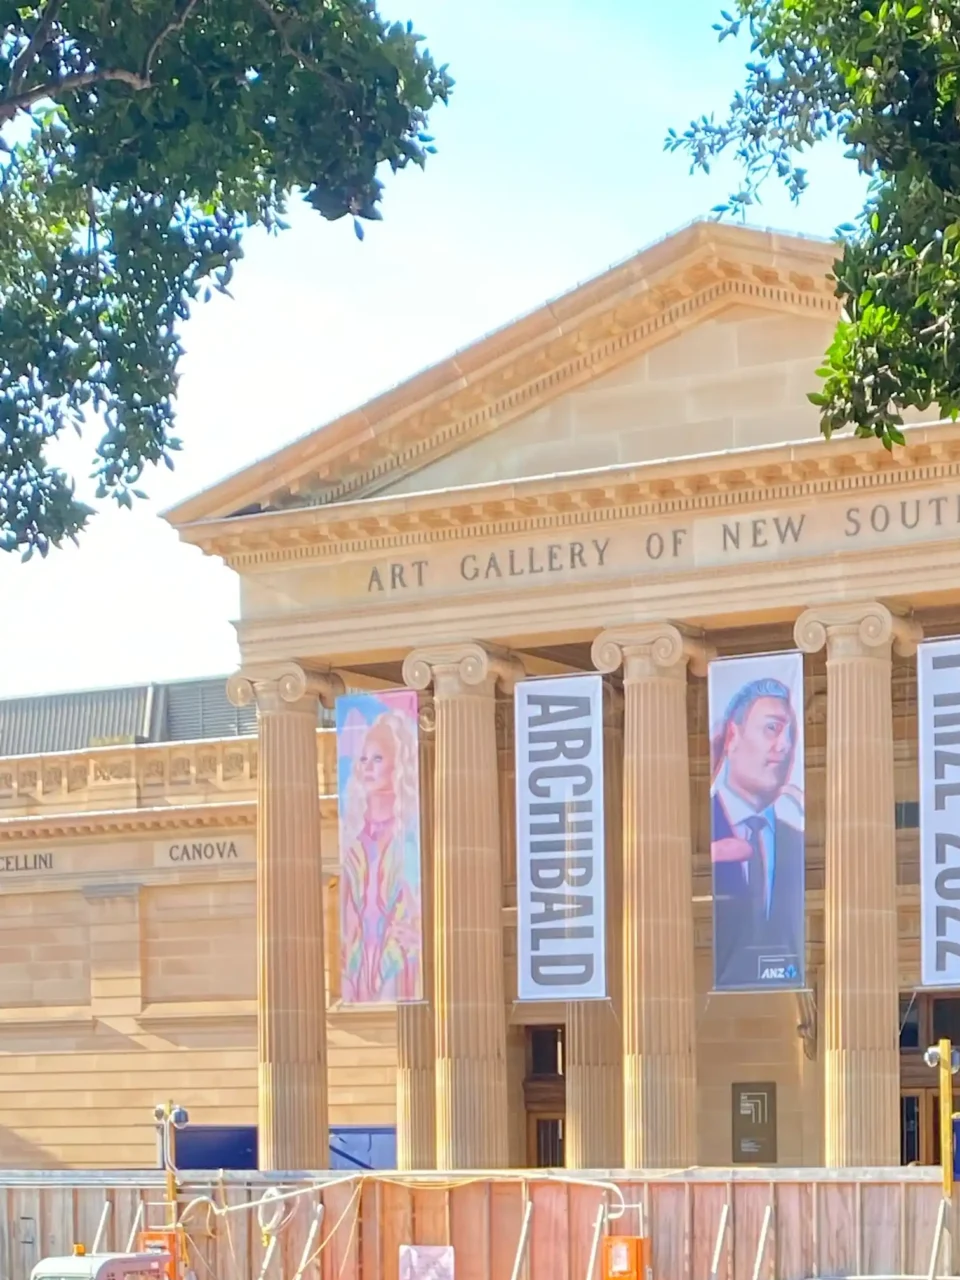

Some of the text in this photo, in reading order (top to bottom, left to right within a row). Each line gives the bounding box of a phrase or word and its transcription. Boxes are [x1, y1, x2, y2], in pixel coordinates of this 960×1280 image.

[367, 560, 429, 593] ART
[460, 537, 611, 582] GALLERY
[645, 529, 688, 560] OF
[722, 514, 806, 551] NEW
[169, 841, 239, 862] CANOVA
[526, 694, 595, 987] ARCHIBALD
[760, 967, 786, 979] ANZ
